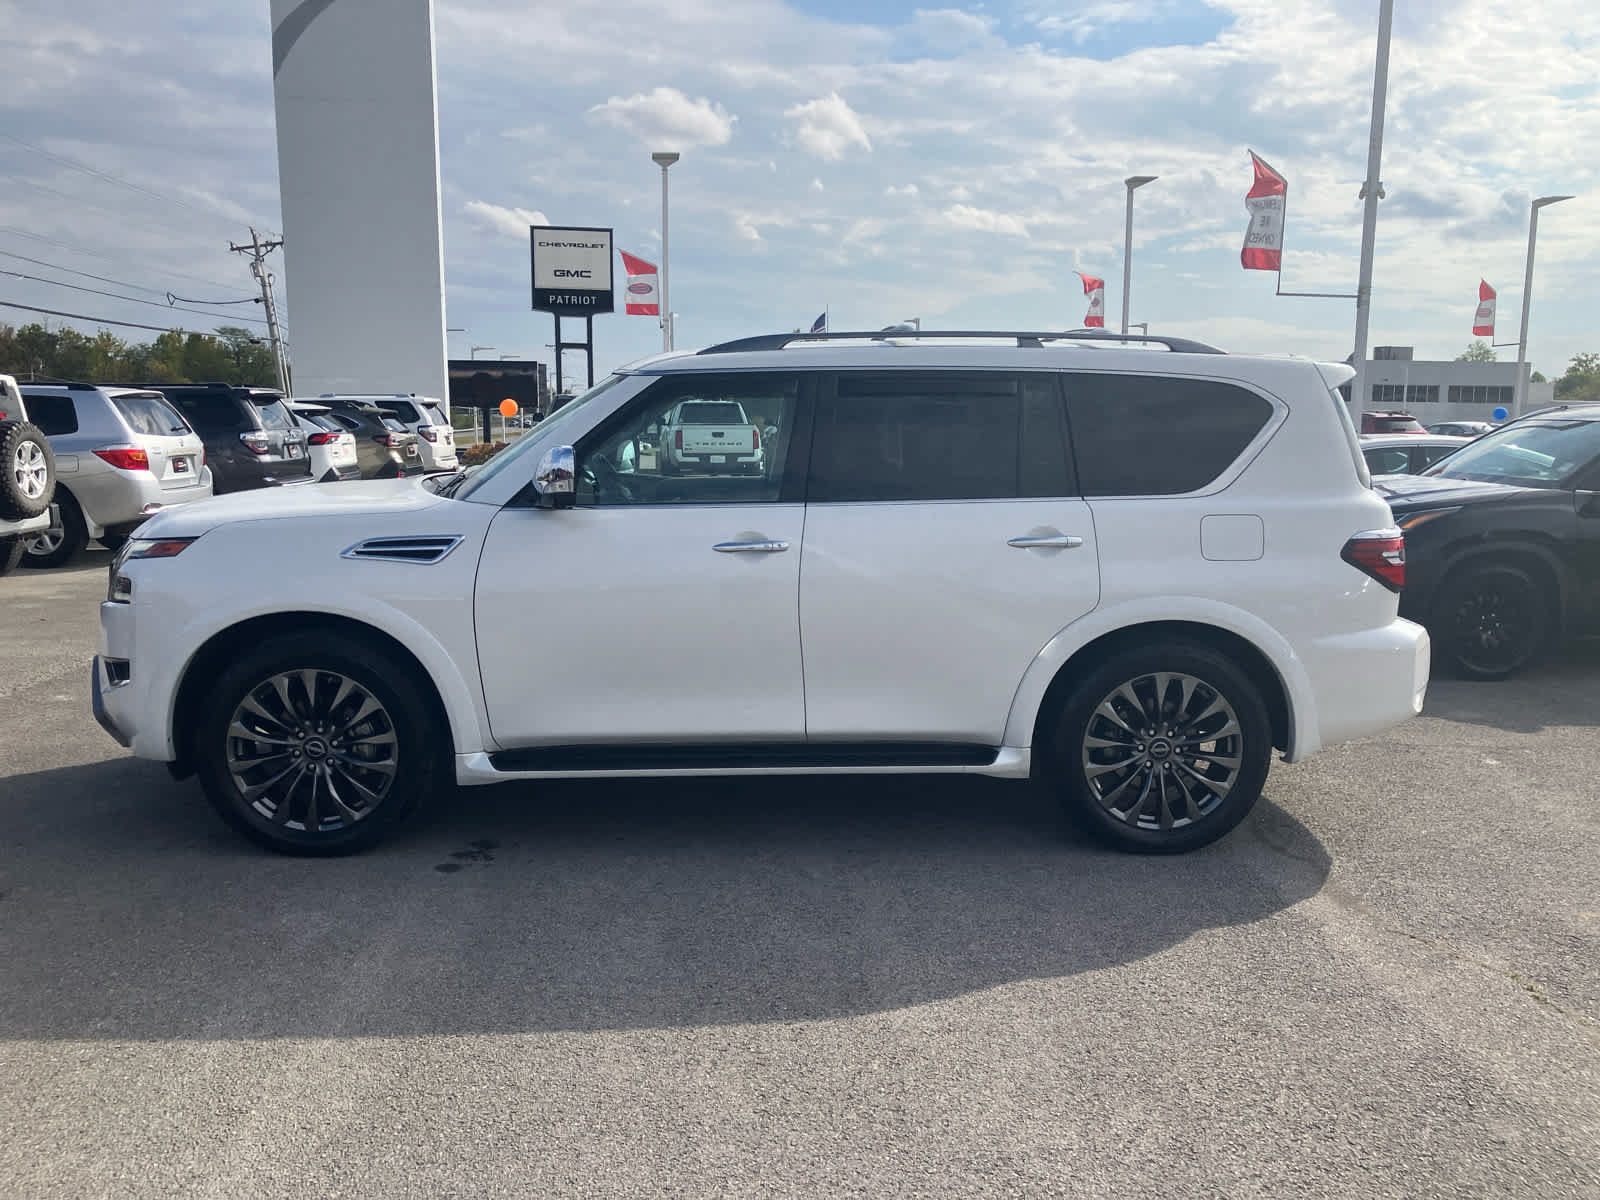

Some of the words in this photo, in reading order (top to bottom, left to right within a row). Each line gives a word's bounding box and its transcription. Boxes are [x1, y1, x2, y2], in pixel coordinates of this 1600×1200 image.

[538, 241, 606, 249] CHEVROLET
[553, 269, 592, 278] GMC
[549, 295, 597, 305] PATRIOT
